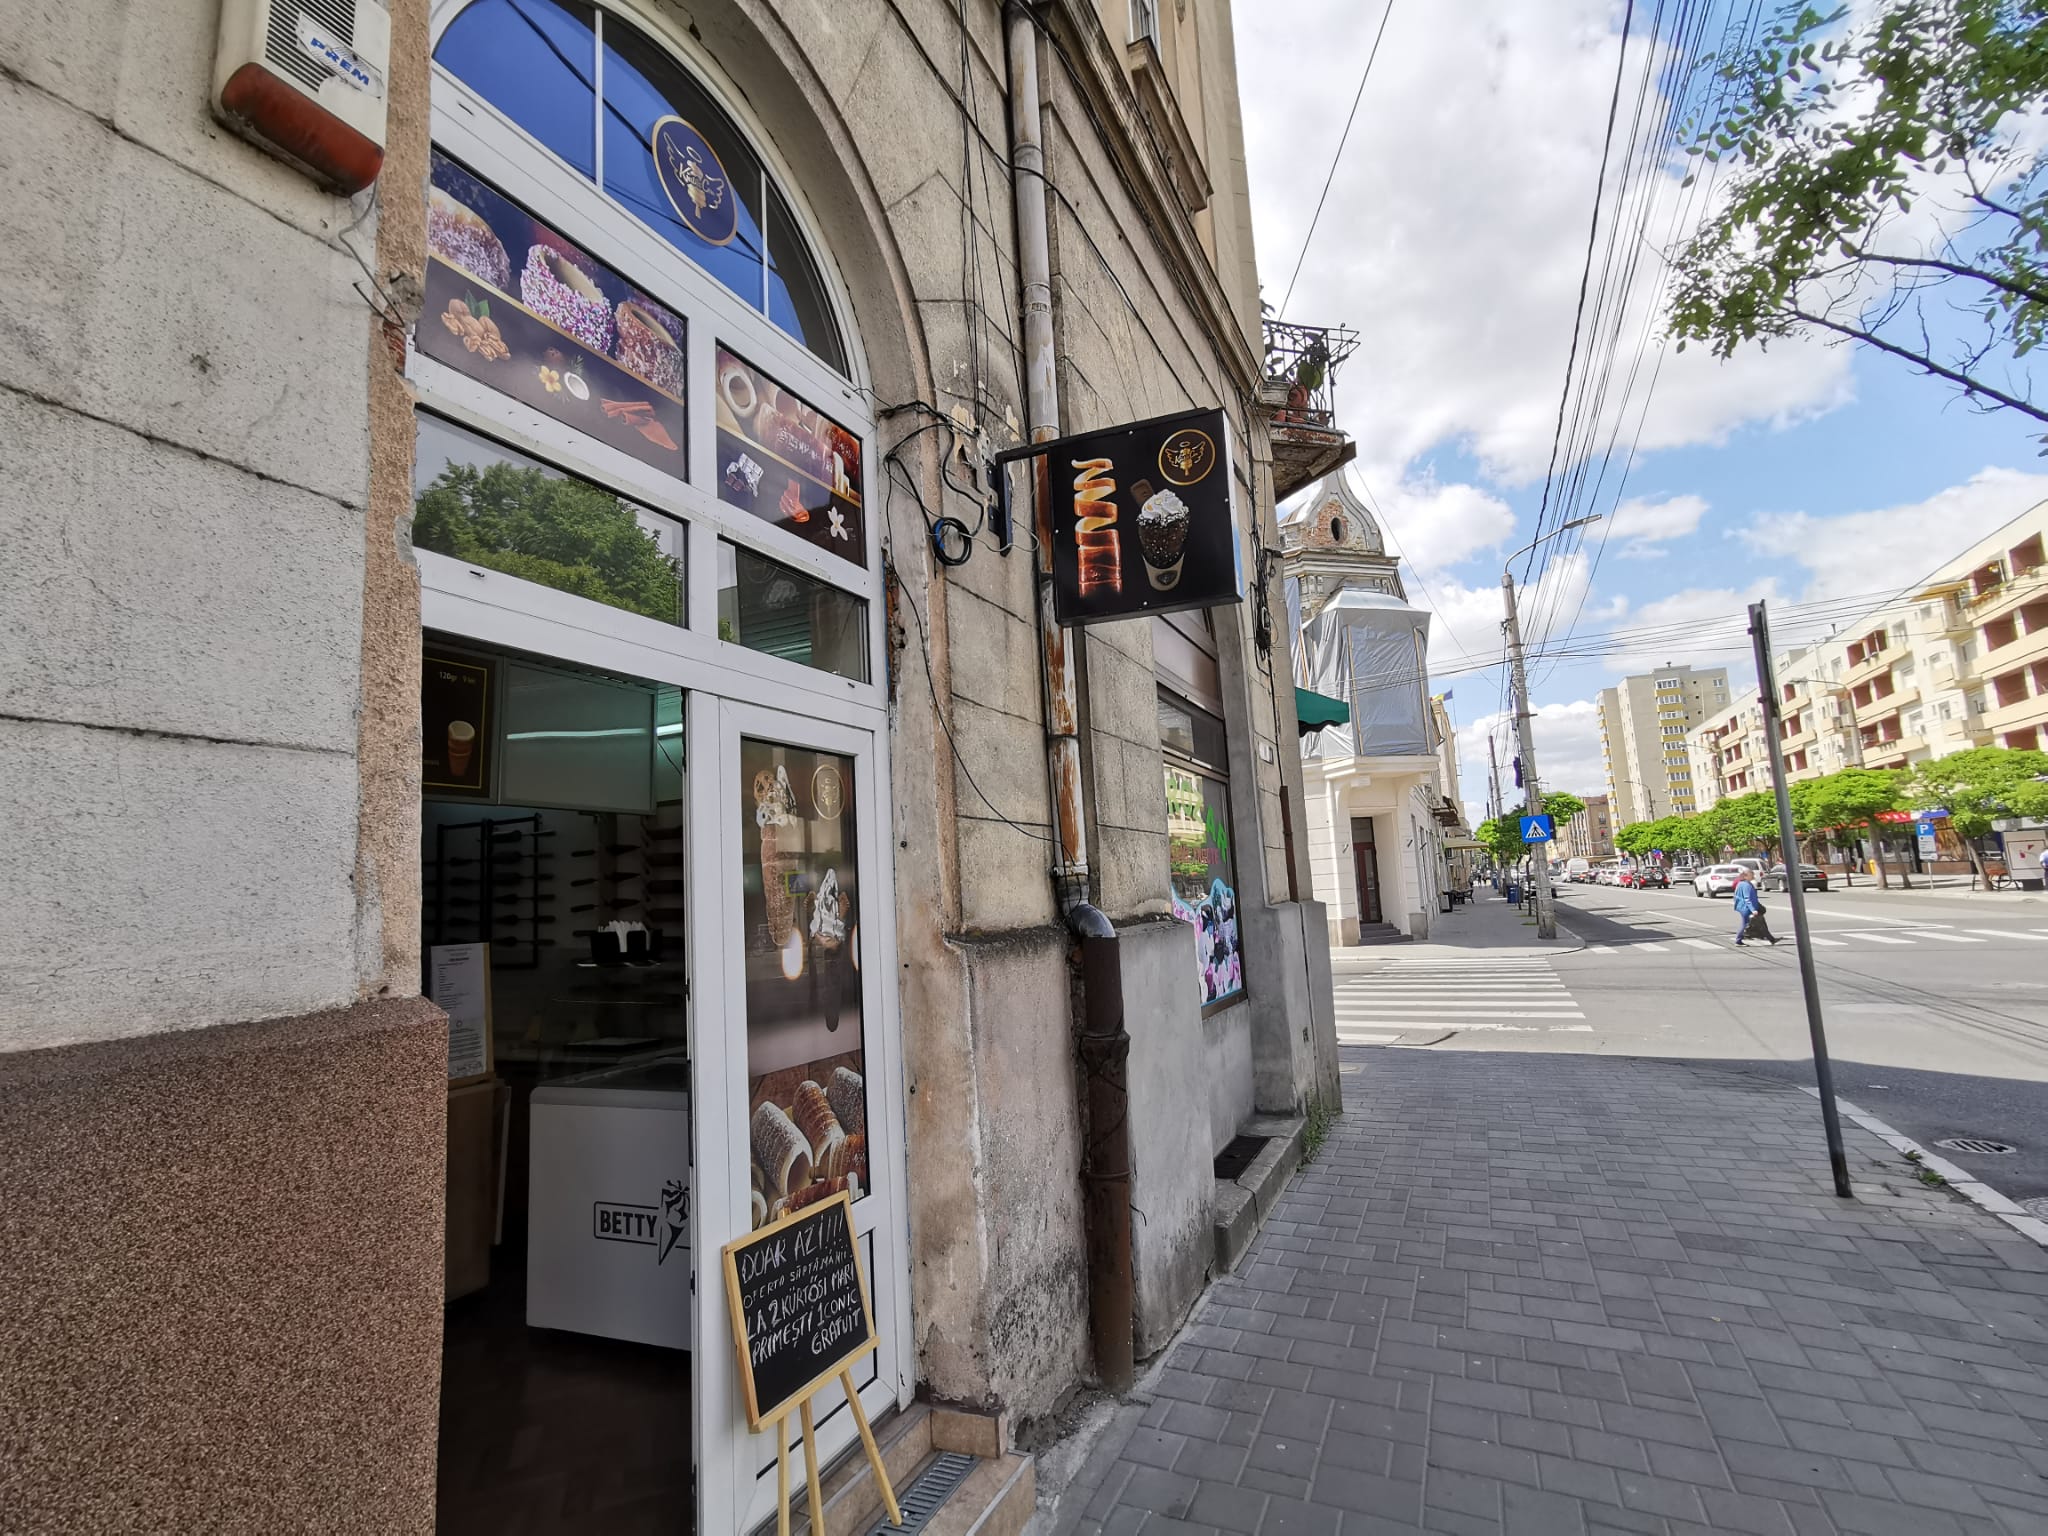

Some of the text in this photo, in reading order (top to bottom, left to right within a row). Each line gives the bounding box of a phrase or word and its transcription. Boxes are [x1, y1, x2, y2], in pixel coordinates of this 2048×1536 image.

[310, 37, 370, 86] PREM
[600, 1209, 658, 1238] BETTY
[741, 1238, 787, 1285] DOAR
[743, 1274, 785, 1309] OFERTA
[747, 1309, 767, 1341] LA
[768, 1299, 782, 1328] 2
[831, 1261, 854, 1291] MARI
[823, 1286, 858, 1319] CONIC
[811, 1306, 861, 1356] GRATUIT
